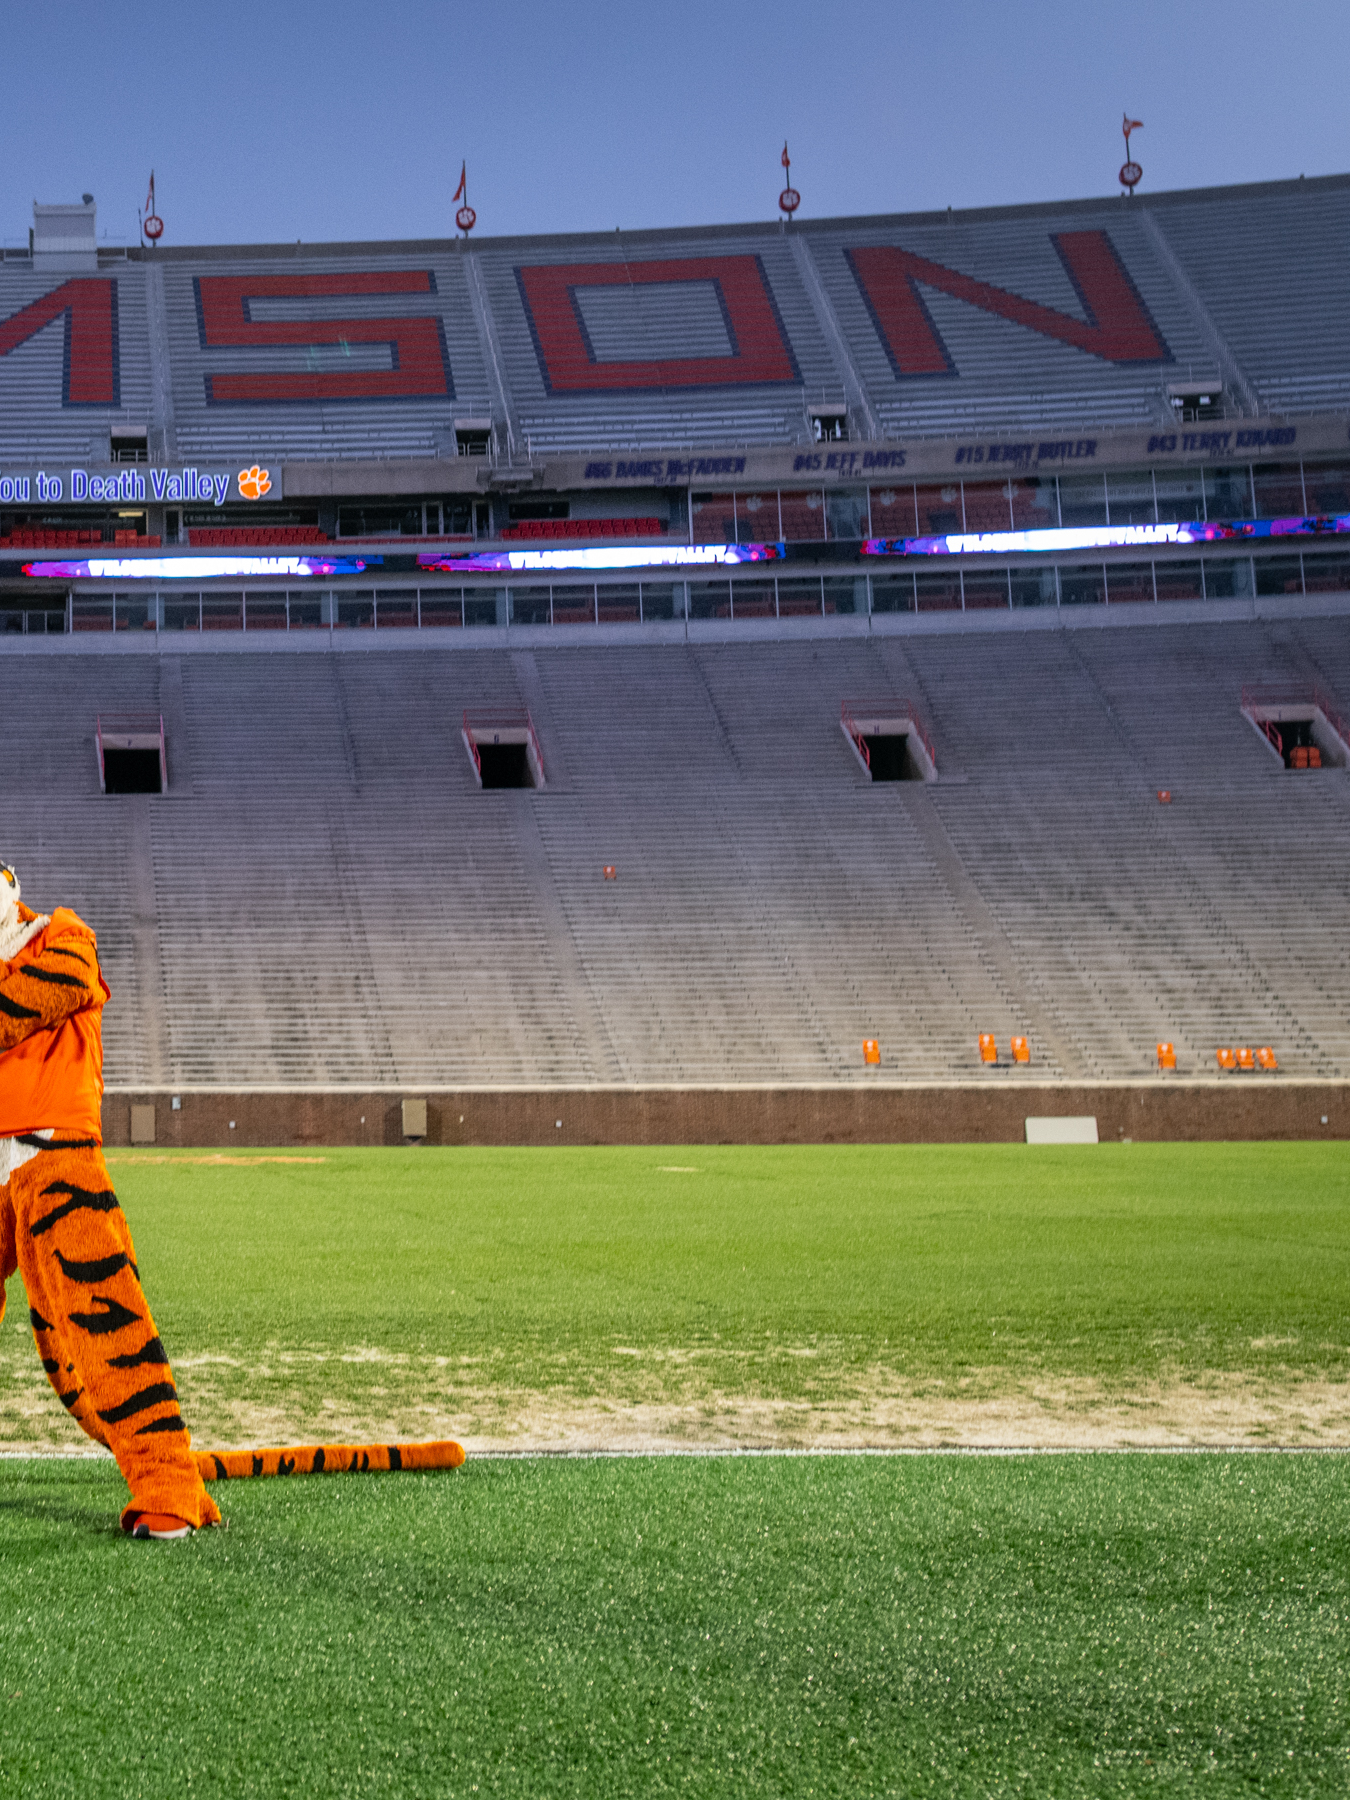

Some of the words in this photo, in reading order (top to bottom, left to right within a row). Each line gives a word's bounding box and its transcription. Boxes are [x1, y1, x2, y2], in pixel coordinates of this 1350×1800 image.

[1182, 431, 1232, 451] TERRY
[824, 451, 860, 470] JEFF
[862, 449, 907, 468] DAVIS
[36, 470, 63, 502] to
[70, 469, 146, 502] Death
[150, 468, 230, 506] Valley
